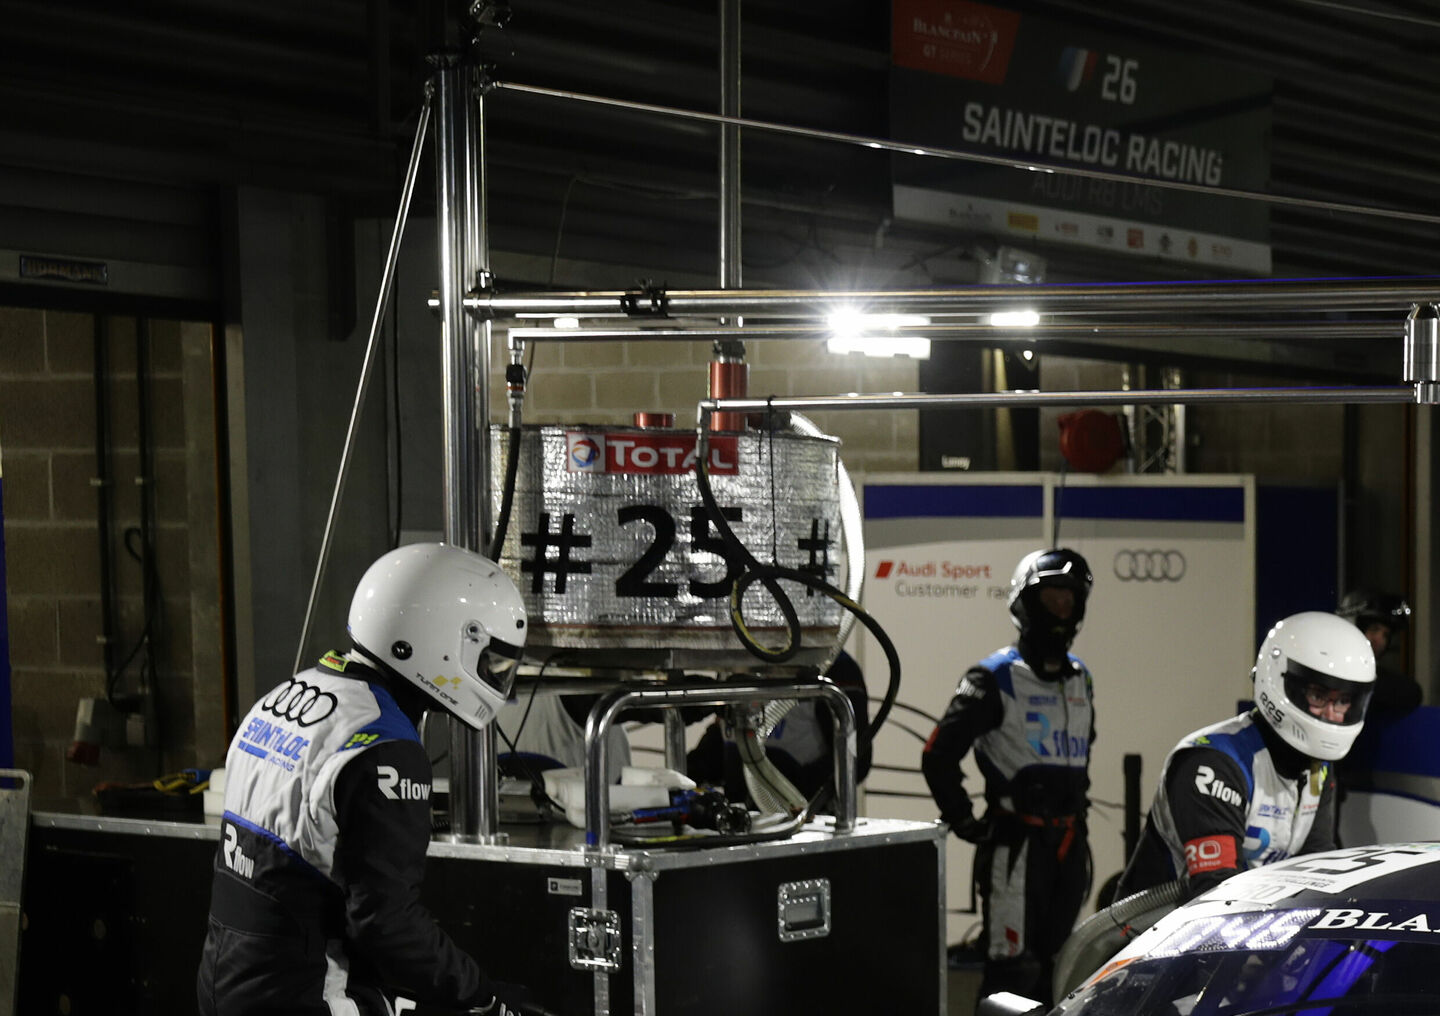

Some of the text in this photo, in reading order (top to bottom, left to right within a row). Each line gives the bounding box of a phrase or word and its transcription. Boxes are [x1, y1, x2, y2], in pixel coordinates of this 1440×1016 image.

[1102, 55, 1139, 104] 26
[962, 102, 1223, 187] SAINTELOC RACING
[896, 581, 977, 597] Customer
[897, 562, 992, 580] Audi Sport
[376, 765, 431, 800] Rflow
[1195, 765, 1242, 808] Rflow
